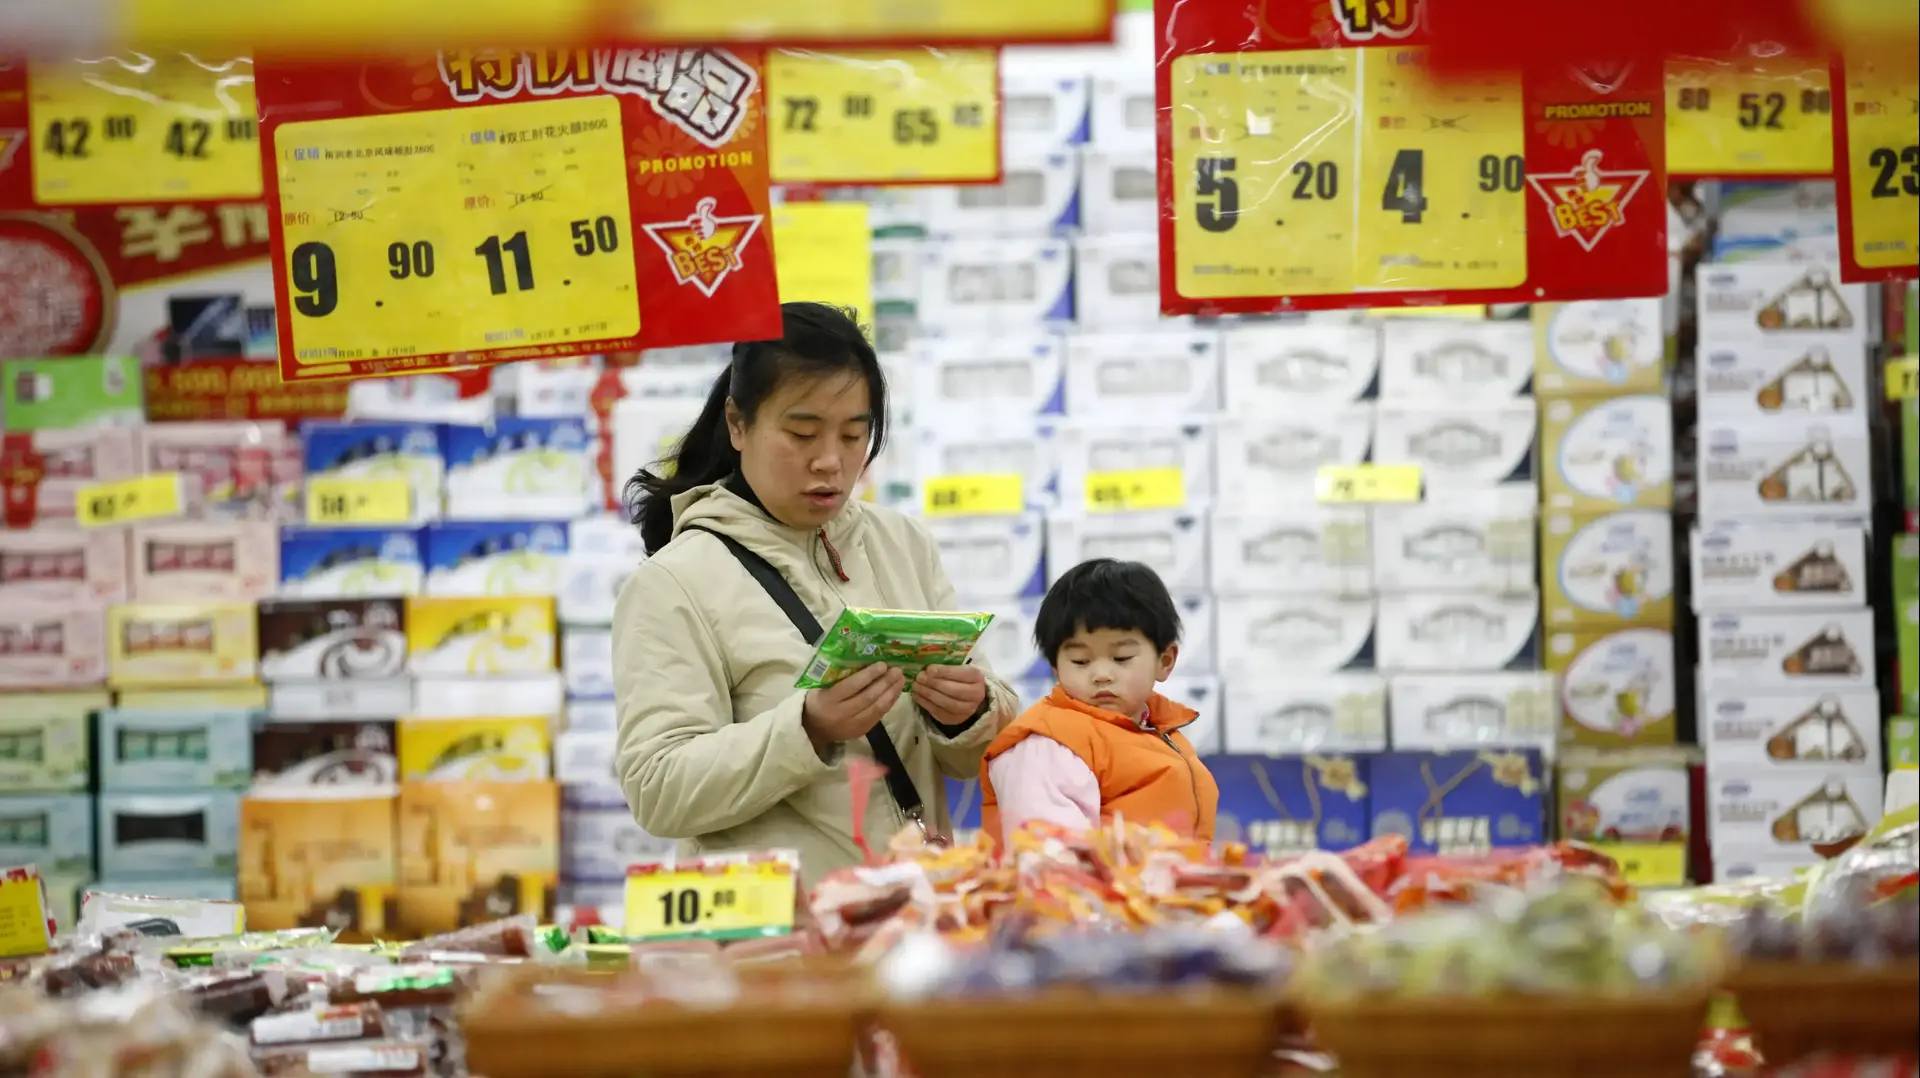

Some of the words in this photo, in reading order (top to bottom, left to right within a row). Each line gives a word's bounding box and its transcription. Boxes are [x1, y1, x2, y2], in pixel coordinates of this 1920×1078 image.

[1545, 102, 1651, 120] PROMOTION
[1738, 92, 1785, 130] 52
[639, 152, 754, 174] PROMOTION
[1554, 202, 1622, 232] BEST
[671, 247, 738, 281] BEST
